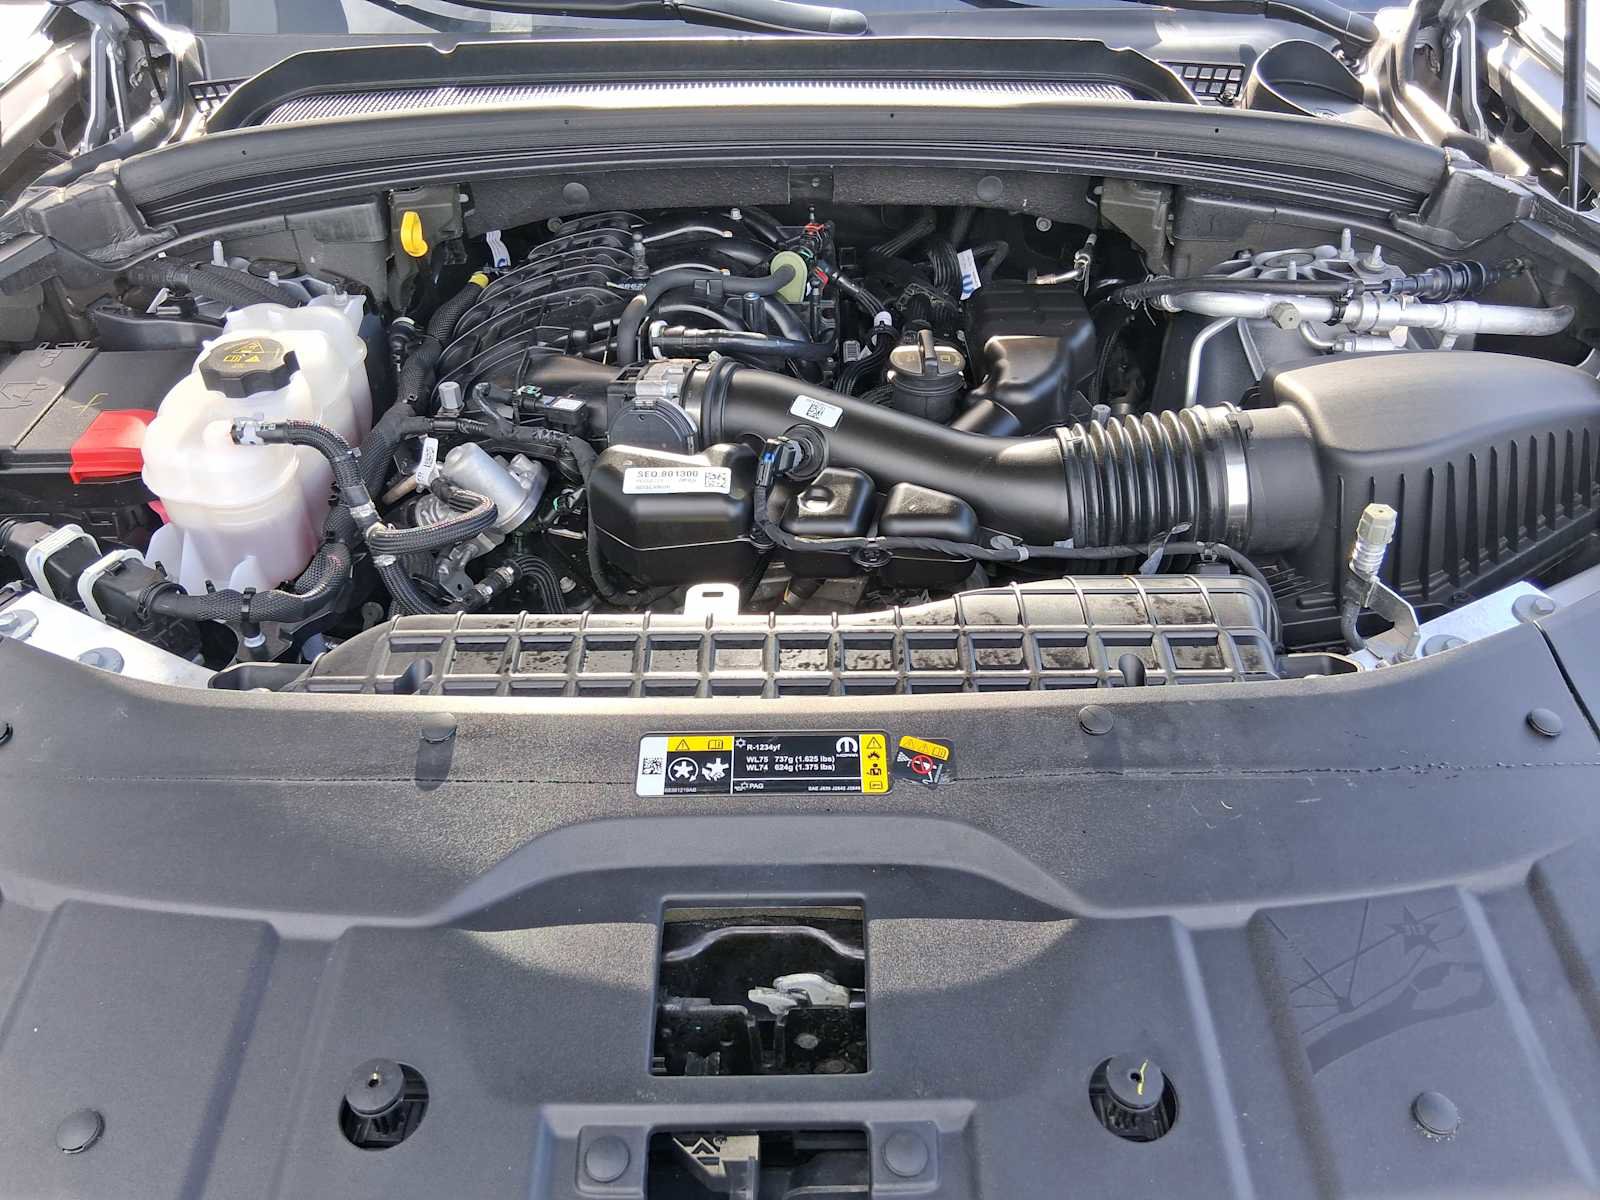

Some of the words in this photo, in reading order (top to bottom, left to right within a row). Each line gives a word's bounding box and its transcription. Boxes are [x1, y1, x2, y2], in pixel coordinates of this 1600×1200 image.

[746, 743, 781, 752] R-1234yf
[746, 755, 769, 763] WL75
[774, 755, 794, 764] 737g
[795, 755, 819, 764] (1.625
[820, 755, 835, 763] lbs)
[746, 763, 769, 771] WL74
[774, 763, 794, 772] 624g
[795, 763, 819, 772] (1.375
[820, 763, 835, 772] lbs)
